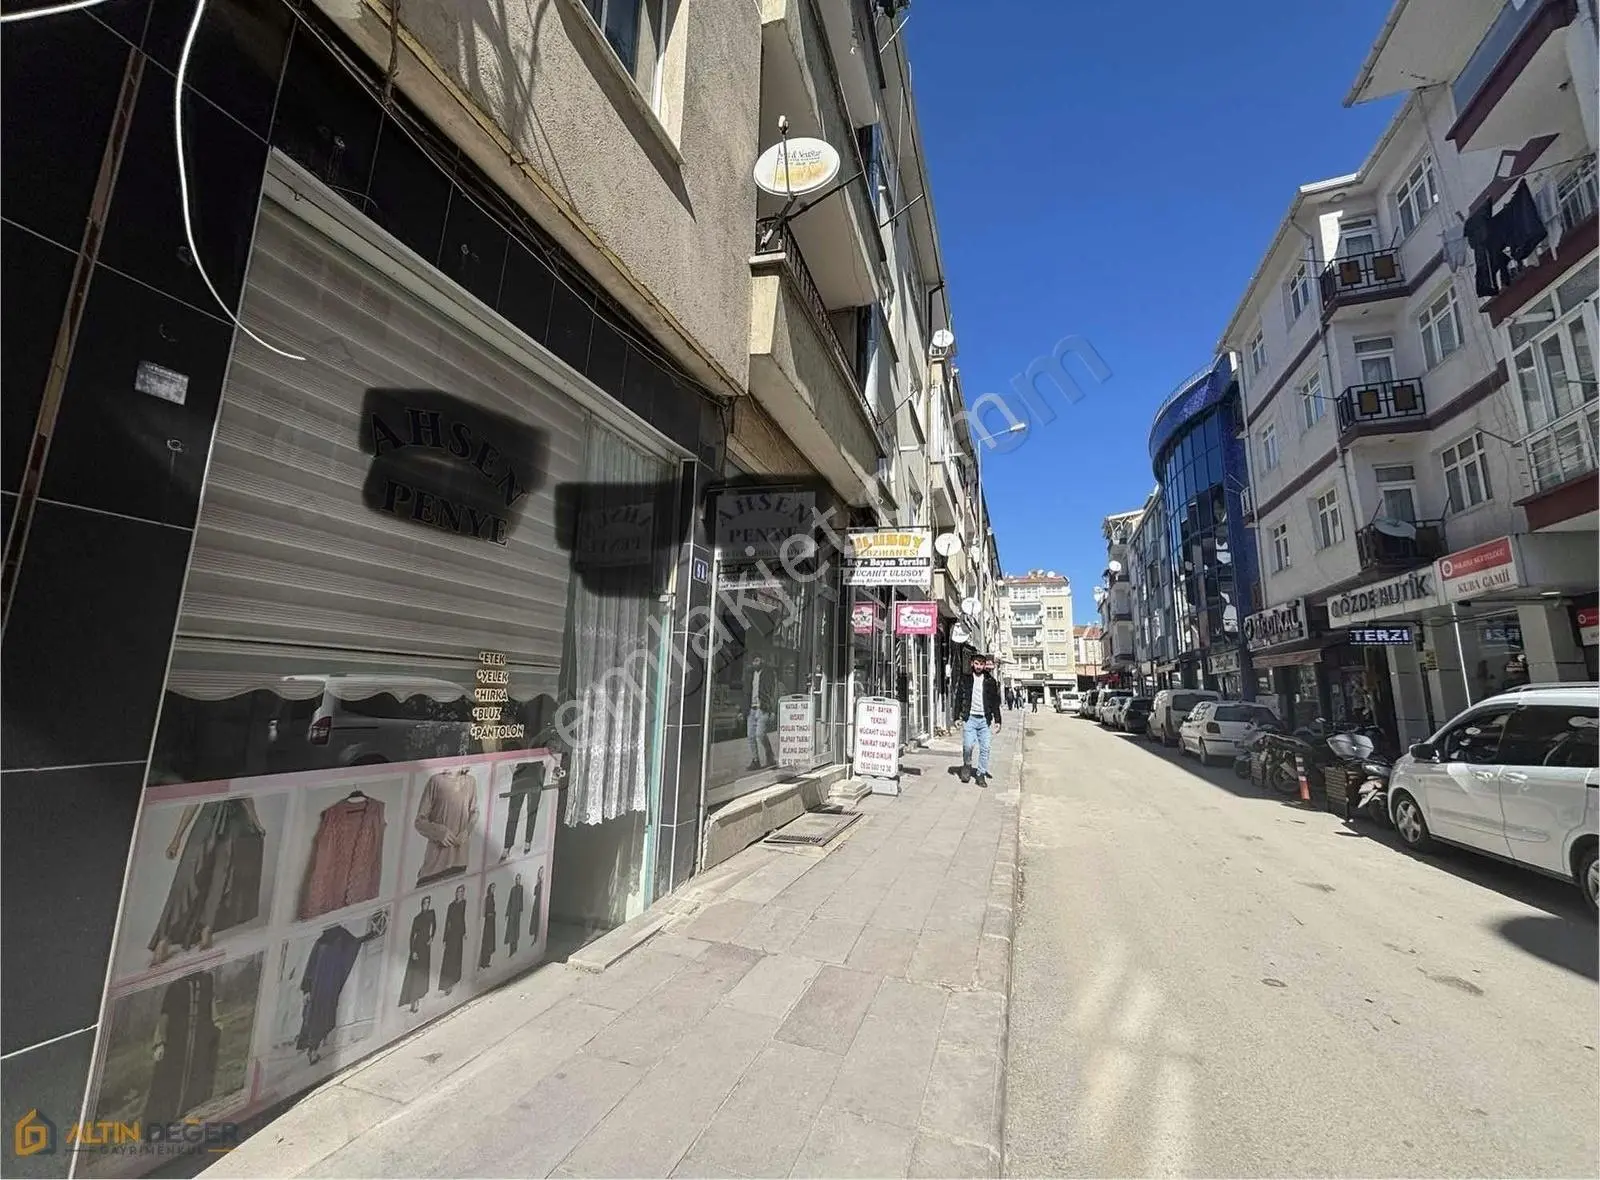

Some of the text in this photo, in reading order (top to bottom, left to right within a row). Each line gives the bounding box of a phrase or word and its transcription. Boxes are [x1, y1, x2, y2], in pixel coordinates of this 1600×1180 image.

[370, 407, 529, 508] AHSEN
[380, 480, 510, 547] PENYE
[483, 652, 507, 665] ETEK
[480, 670, 509, 684] YELEK
[479, 688, 509, 702] HIRKA
[477, 706, 502, 720] BLUZ
[475, 723, 525, 740] PANTOLON
